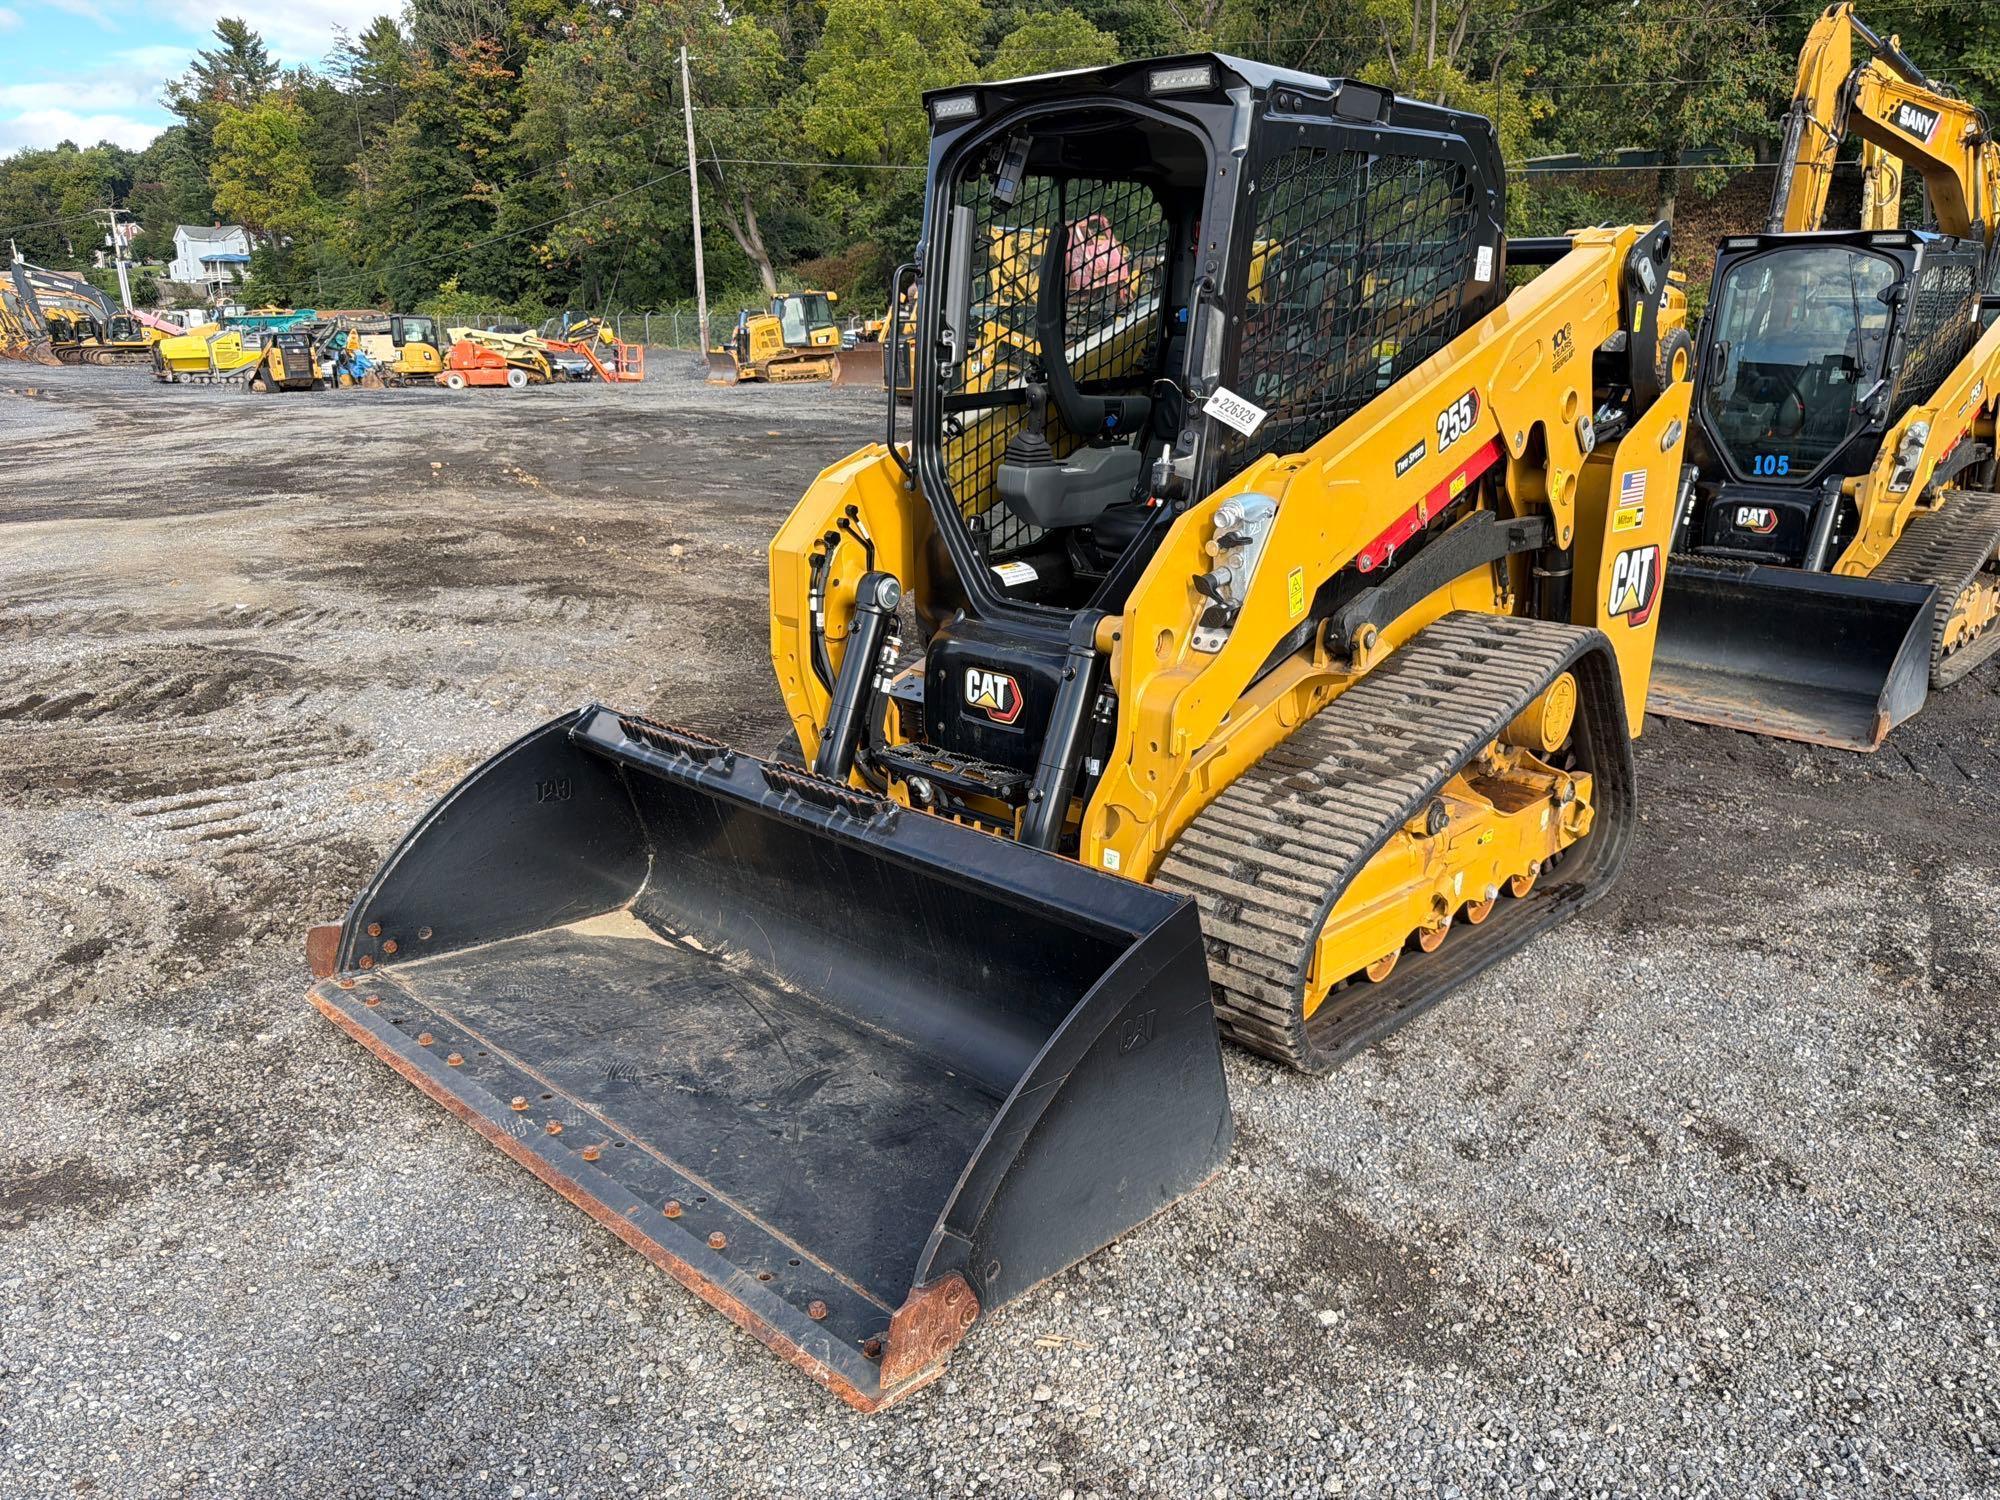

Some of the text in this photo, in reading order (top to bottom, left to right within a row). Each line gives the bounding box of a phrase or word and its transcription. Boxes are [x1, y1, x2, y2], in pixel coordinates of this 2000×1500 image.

[1899, 105, 1933, 135] SANY
[1552, 339, 1572, 360] YEARS
[1219, 398, 1256, 424] 226329
[1437, 393, 1472, 452] 255
[1752, 454, 1789, 476] 105
[1736, 507, 1769, 527] CAT
[1609, 547, 1655, 616] CAT
[966, 669, 1008, 710] CAT
